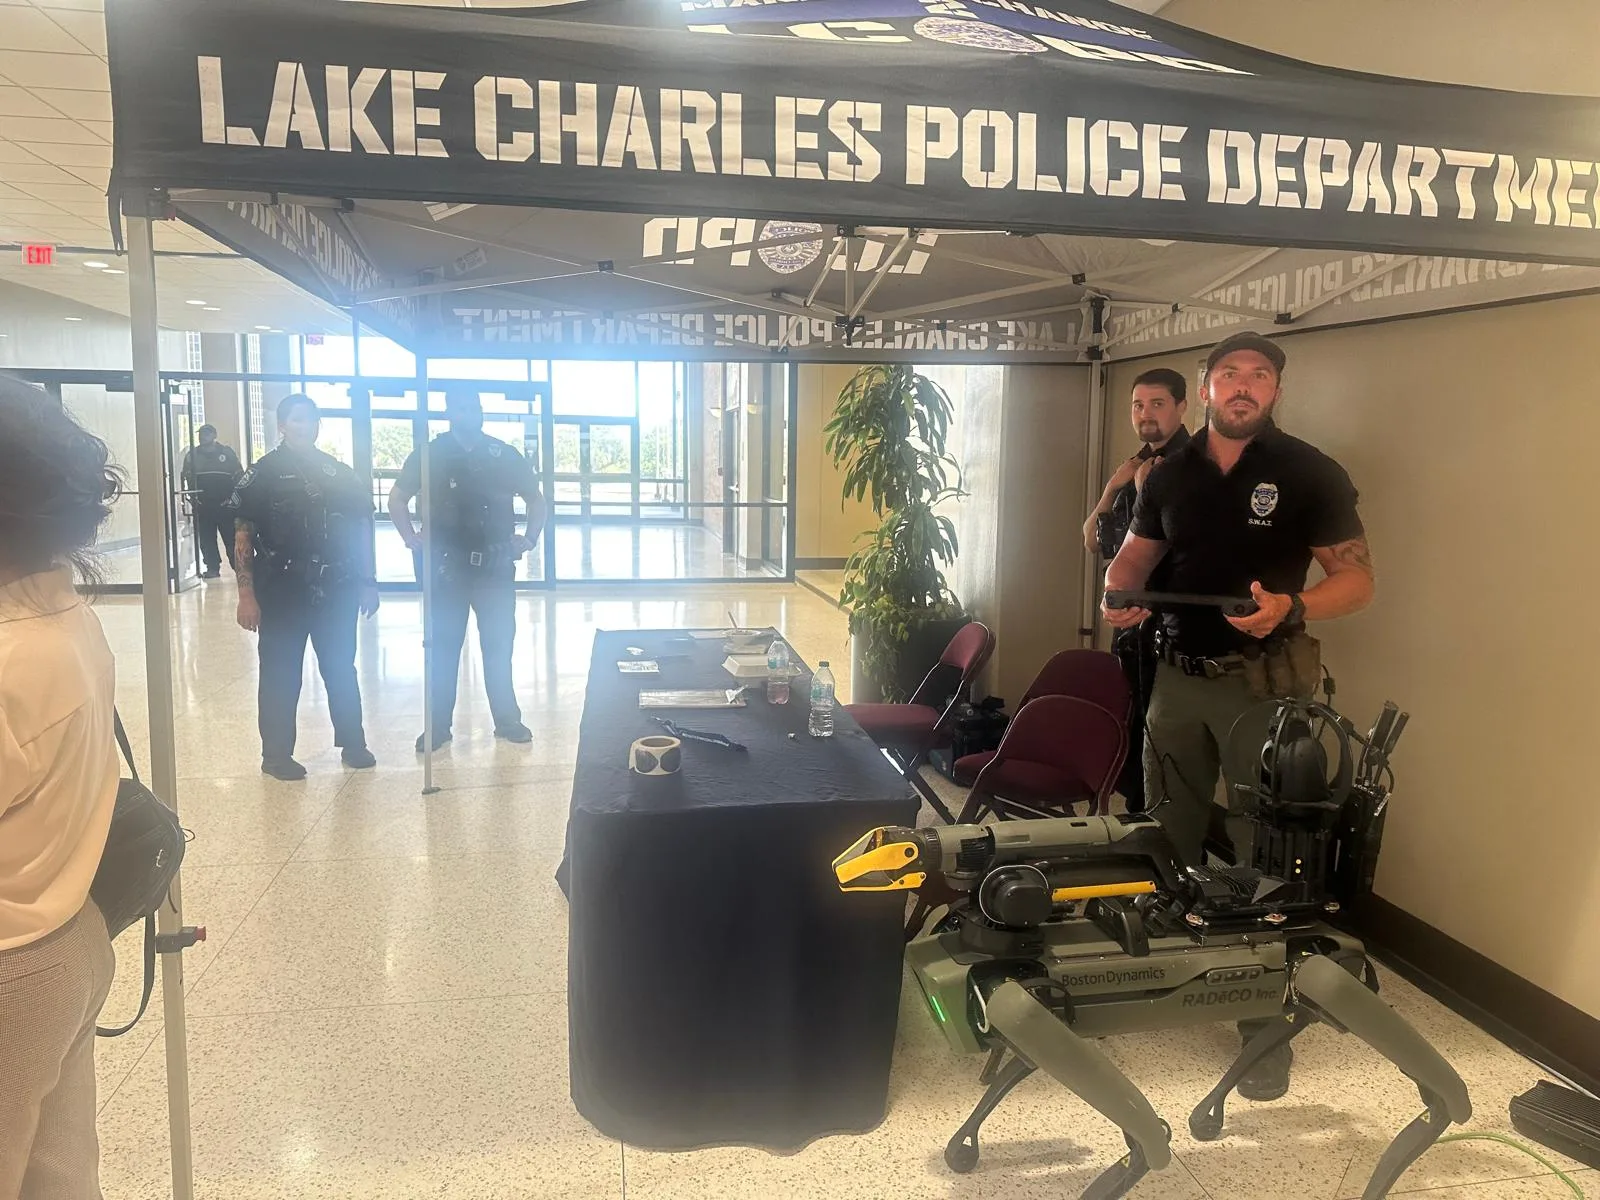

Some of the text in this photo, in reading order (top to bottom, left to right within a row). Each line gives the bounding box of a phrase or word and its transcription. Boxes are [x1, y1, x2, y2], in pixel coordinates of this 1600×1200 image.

[197, 55, 1600, 230] LAKE CHARLES POLICE DEPARTME
